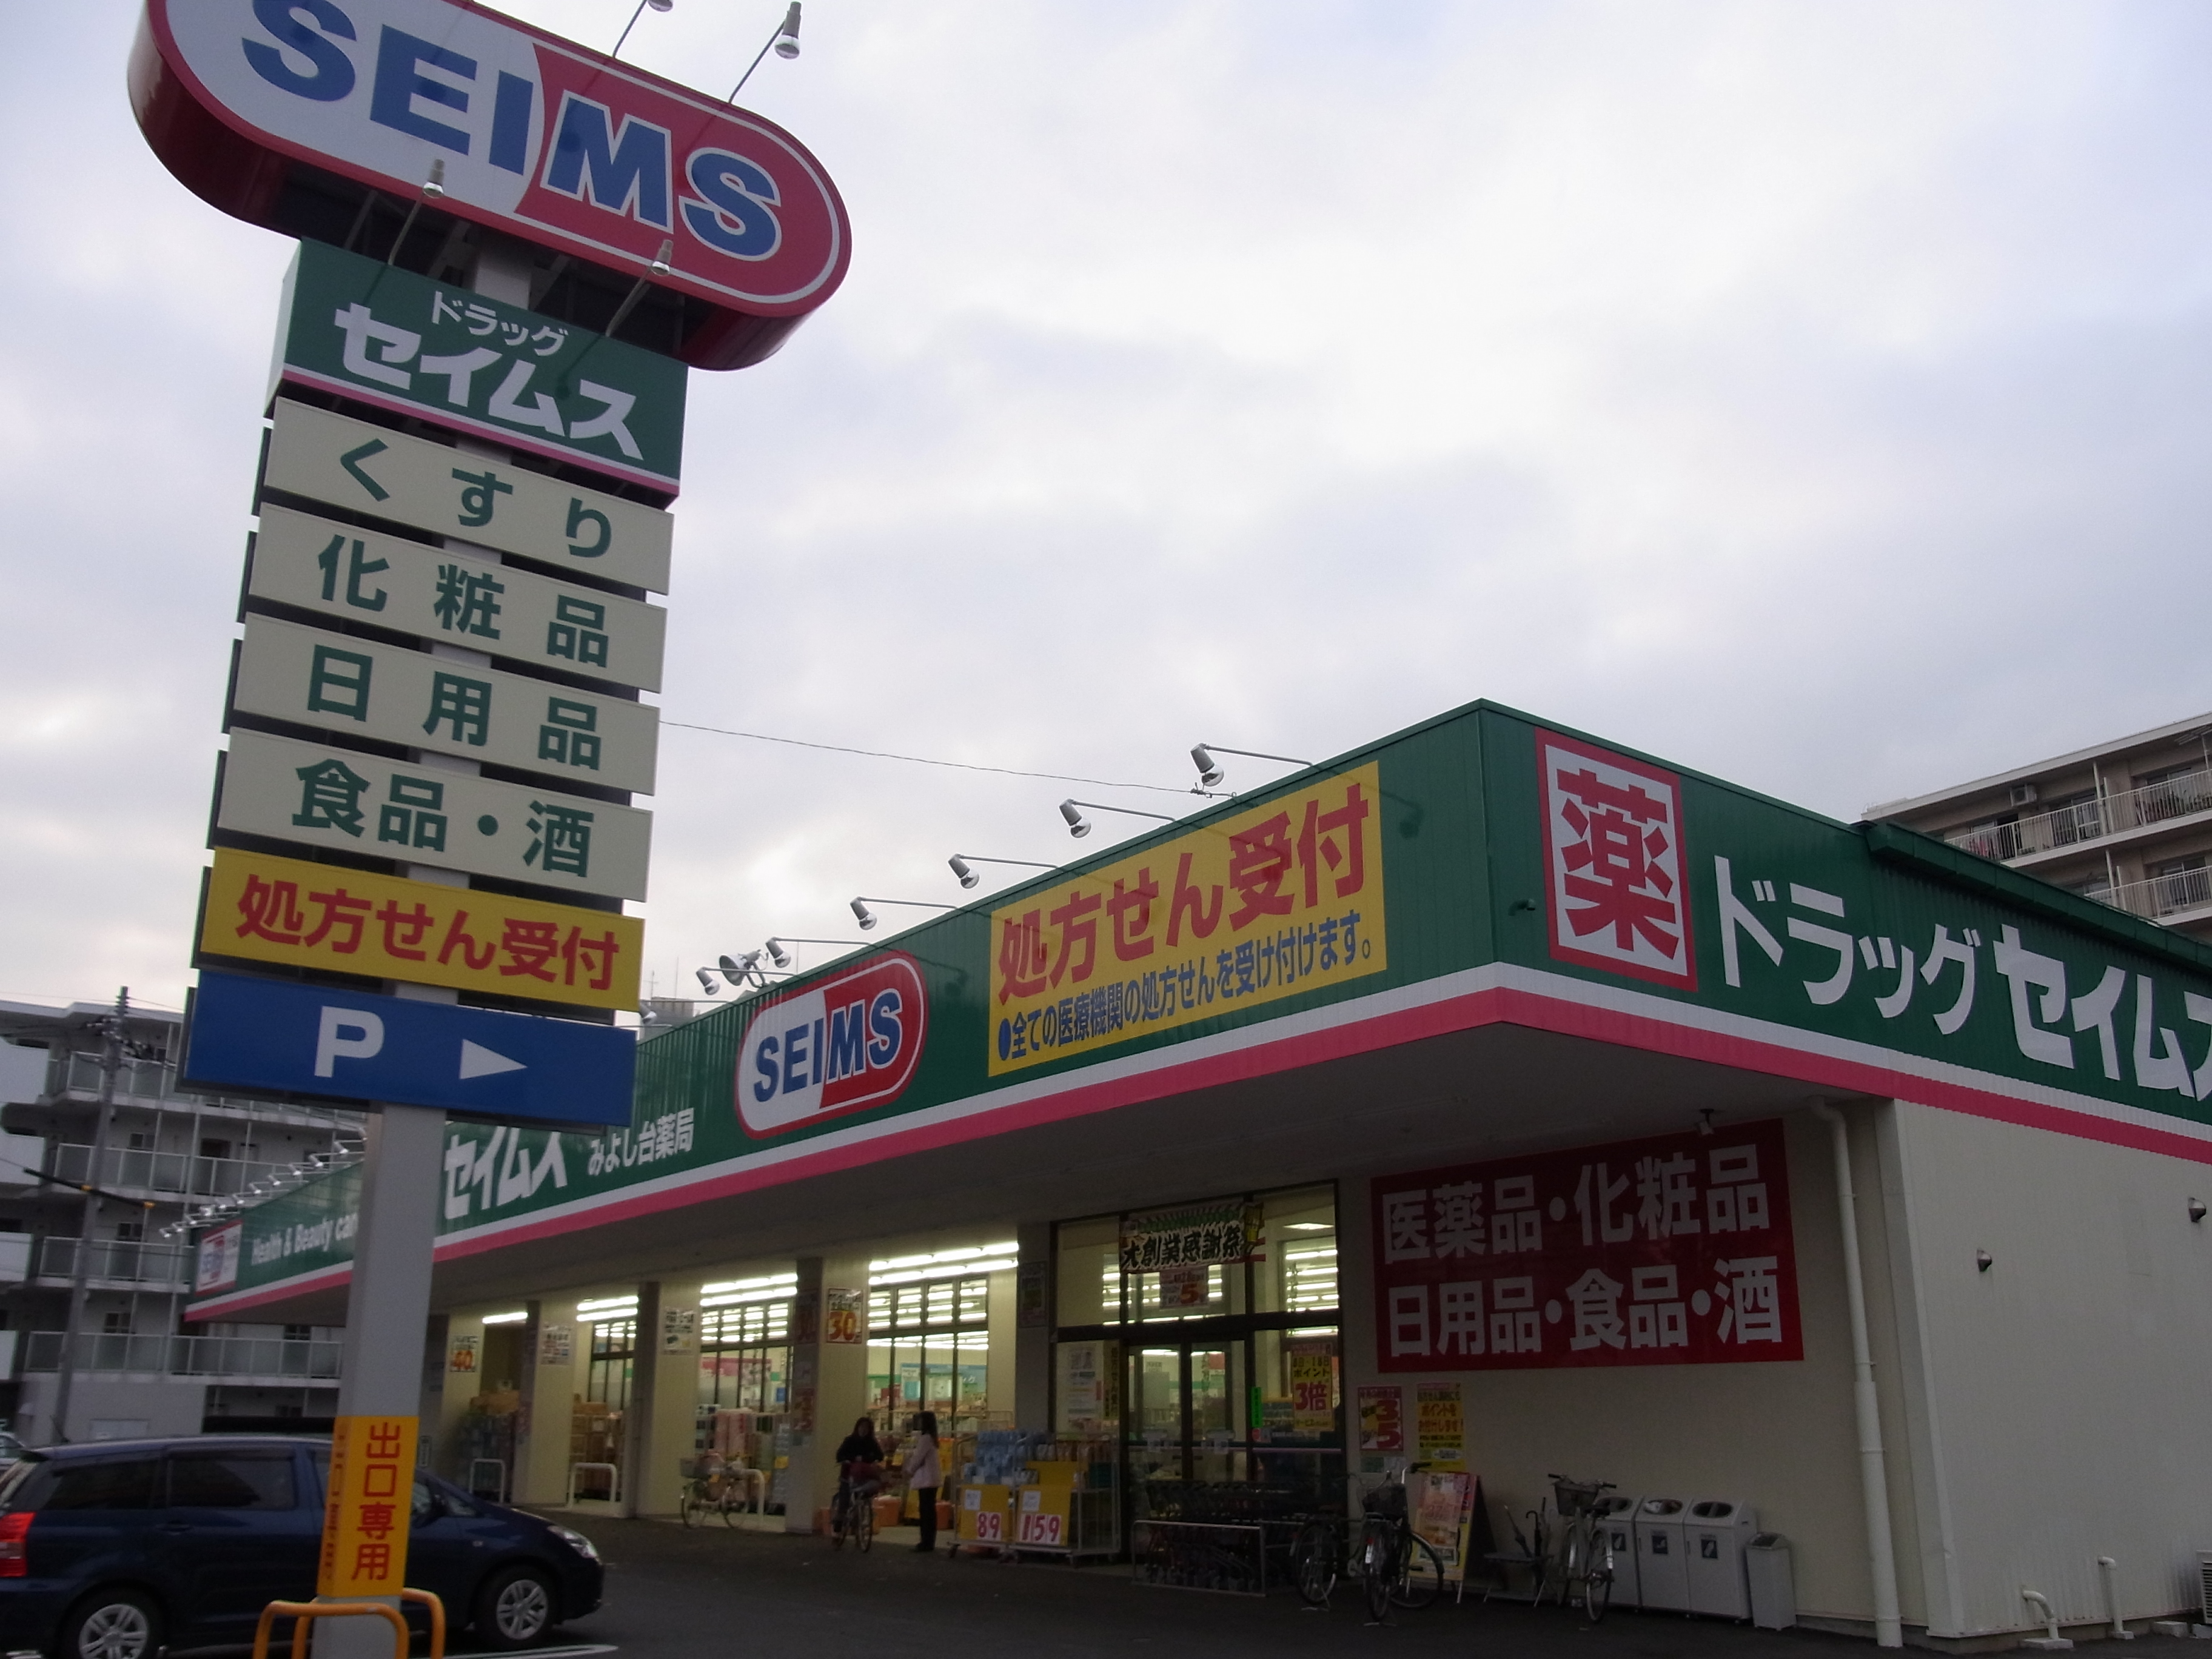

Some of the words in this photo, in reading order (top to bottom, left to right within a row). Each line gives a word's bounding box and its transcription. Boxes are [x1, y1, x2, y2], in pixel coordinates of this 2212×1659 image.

[243, 0, 781, 261] SEIMS
[334, 302, 643, 460] セイムス
[432, 291, 567, 357] ドラッグ
[340, 438, 611, 558] くすり
[318, 534, 610, 668] 化粧品
[307, 645, 602, 771] 日用品
[292, 758, 594, 878] 食品・酒
[1557, 767, 1678, 960] 薬
[236, 874, 620, 991] 処方せん受付
[999, 783, 1369, 1005] 処方せん受付
[314, 1006, 384, 1078] P
[752, 987, 903, 1102] SEIMS
[587, 1107, 695, 1176] みよし台薬局
[250, 1232, 283, 1266] Health
[294, 1217, 333, 1253] Beauty
[1382, 1144, 1770, 1264] 医薬品・化粧品
[1388, 1256, 1783, 1357] 日用品・食品・酒
[351, 1421, 401, 1581] 出口専用
[978, 1513, 1000, 1538] 89
[1022, 1515, 1061, 1542] 159
